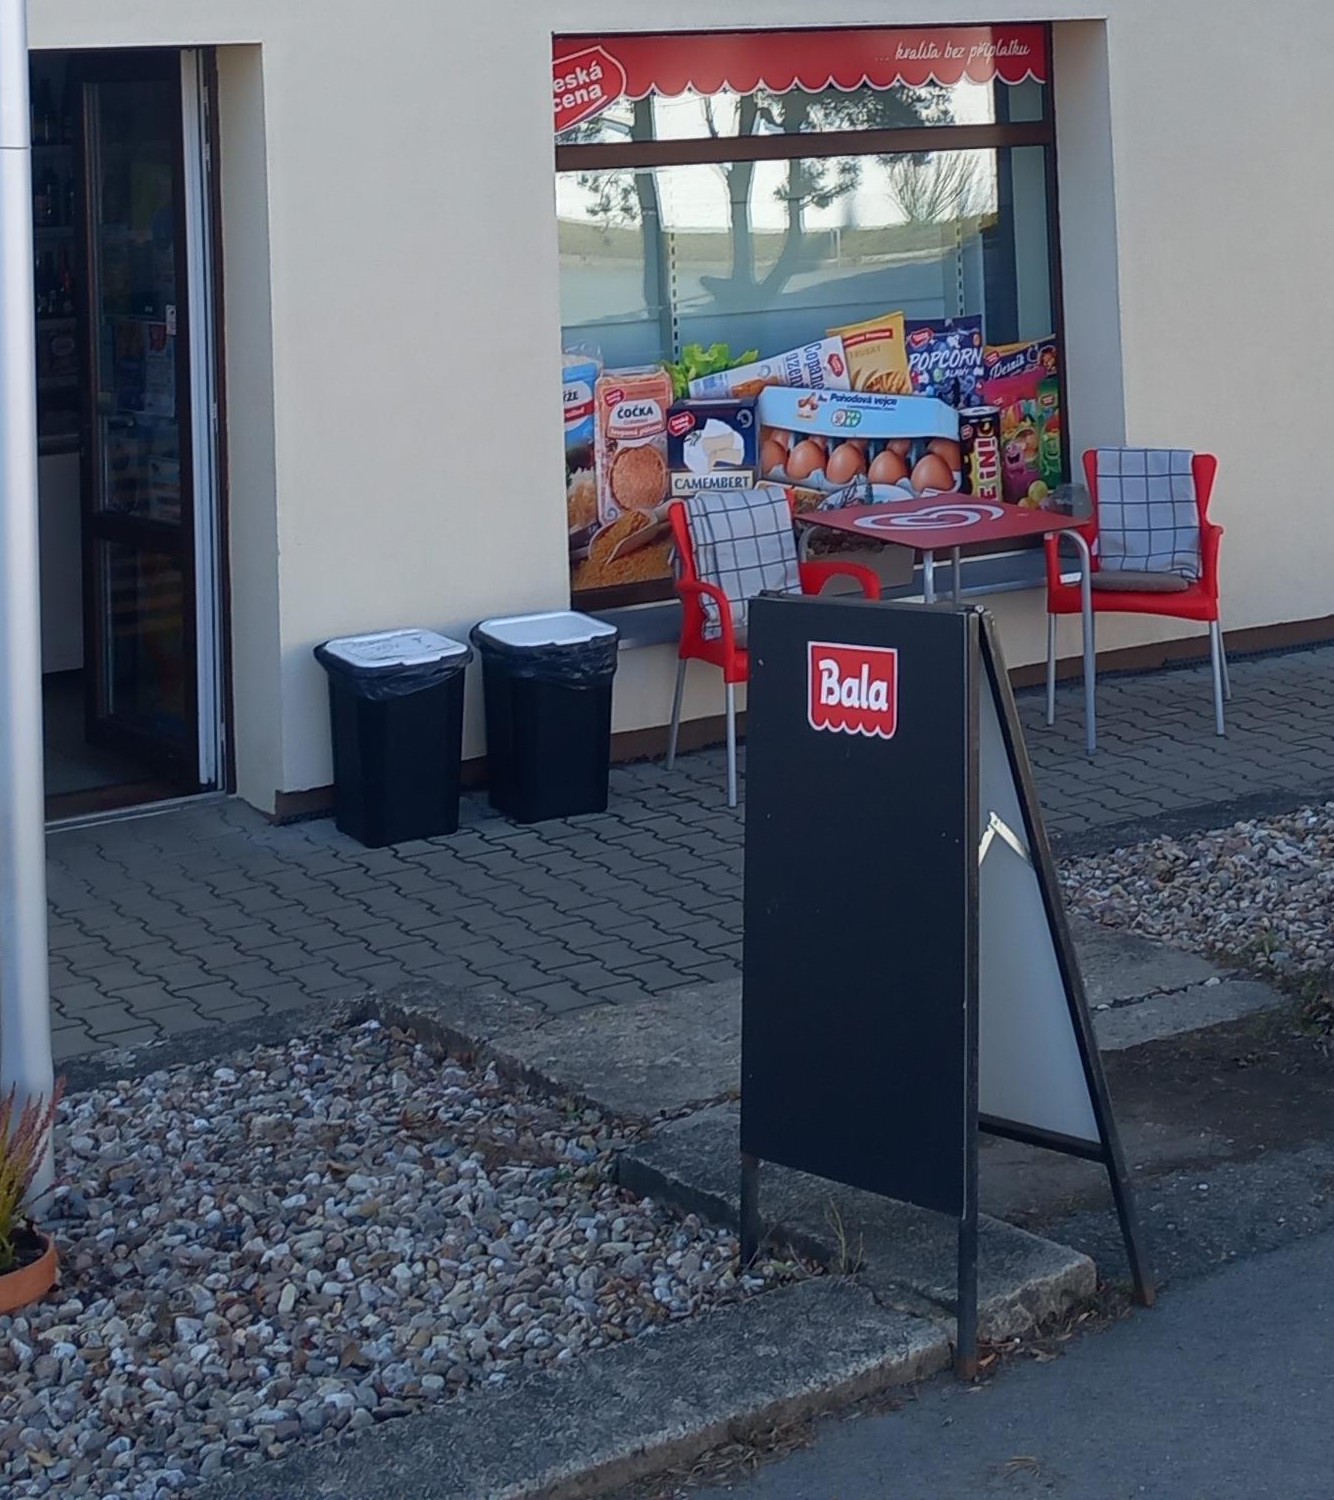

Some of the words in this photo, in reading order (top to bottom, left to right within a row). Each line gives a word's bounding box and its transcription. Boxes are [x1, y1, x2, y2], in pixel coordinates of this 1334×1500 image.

[895, 39, 942, 60] kvalita
[944, 41, 964, 59] bez
[968, 39, 1031, 65] příplatku
[554, 60, 603, 93] eská
[554, 84, 603, 113] cena
[908, 348, 983, 370] POPCORN
[616, 405, 654, 420] ČOČKA
[674, 476, 751, 490] CAMEMBERT
[818, 658, 889, 712] Bala
